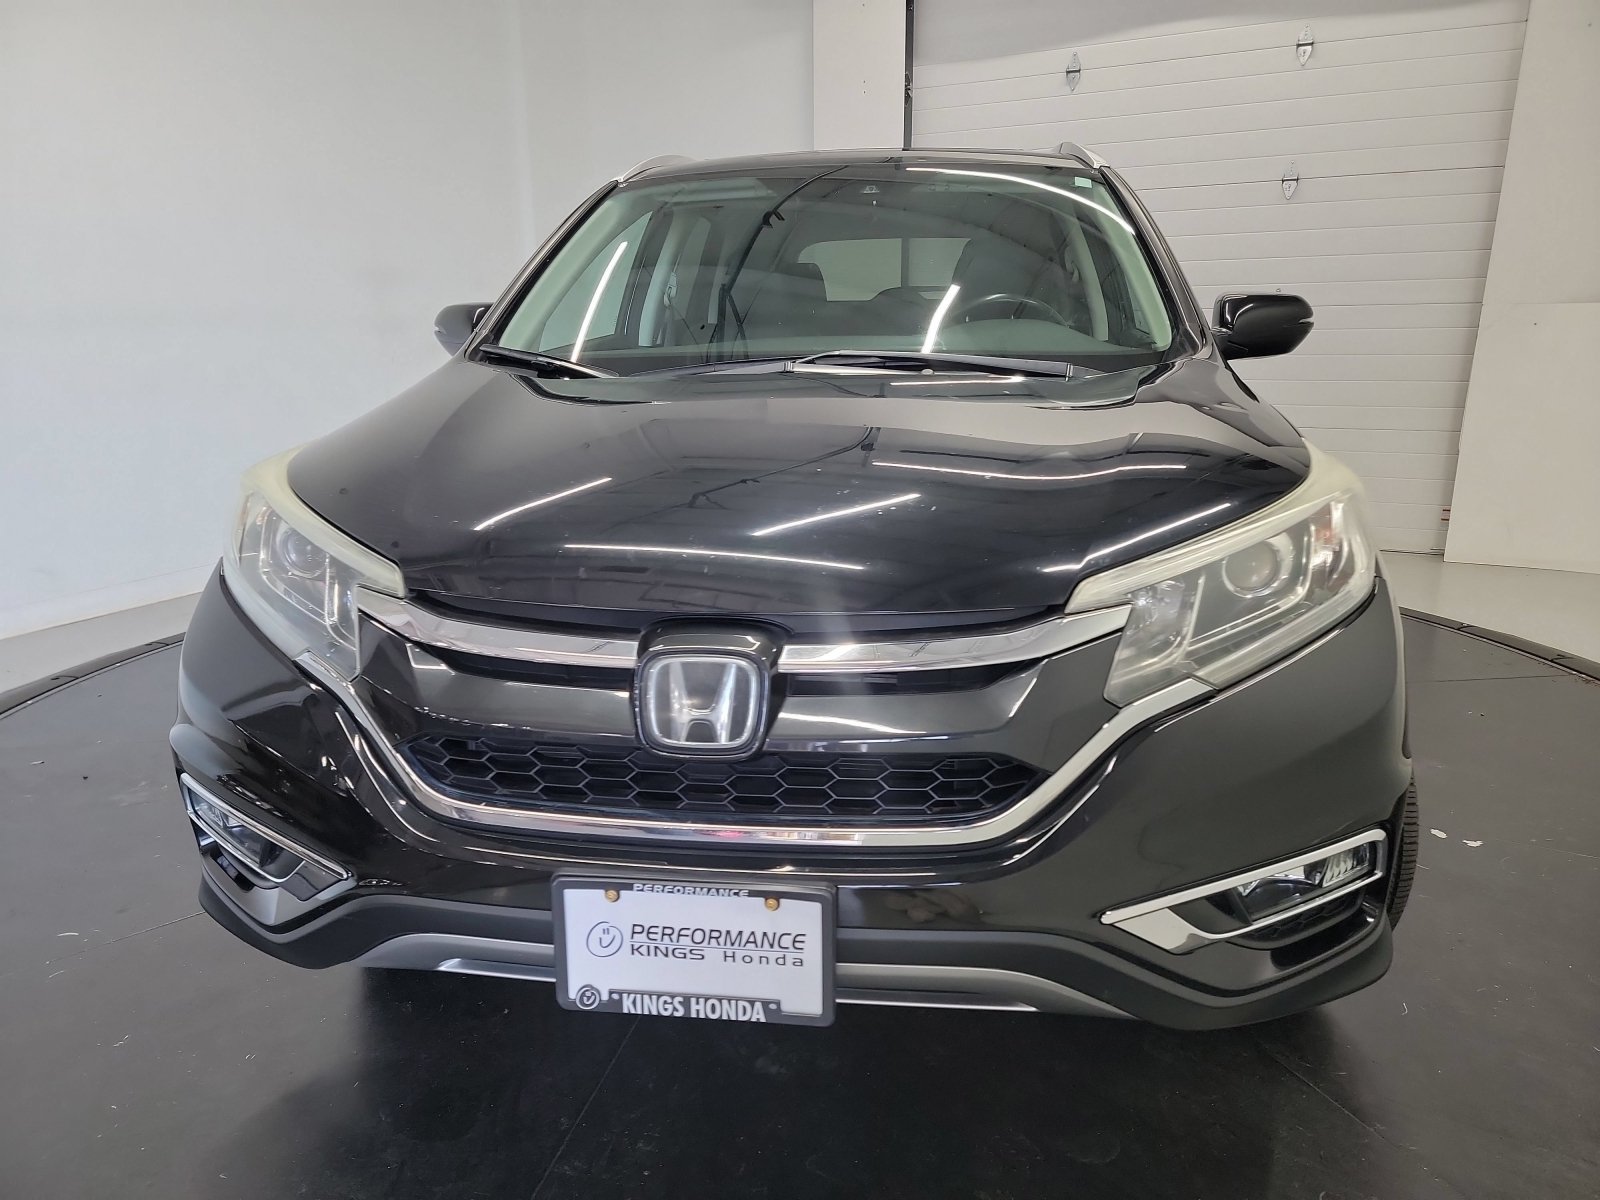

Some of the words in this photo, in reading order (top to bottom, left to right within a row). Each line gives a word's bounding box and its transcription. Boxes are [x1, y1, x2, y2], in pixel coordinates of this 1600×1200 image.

[632, 883, 750, 898] PERFORMANCE
[631, 923, 807, 950] PERFORMANCE
[630, 943, 705, 960] KINGS
[723, 951, 804, 967] Honda
[622, 993, 685, 1017] KINGS
[690, 997, 767, 1022] HONDA
